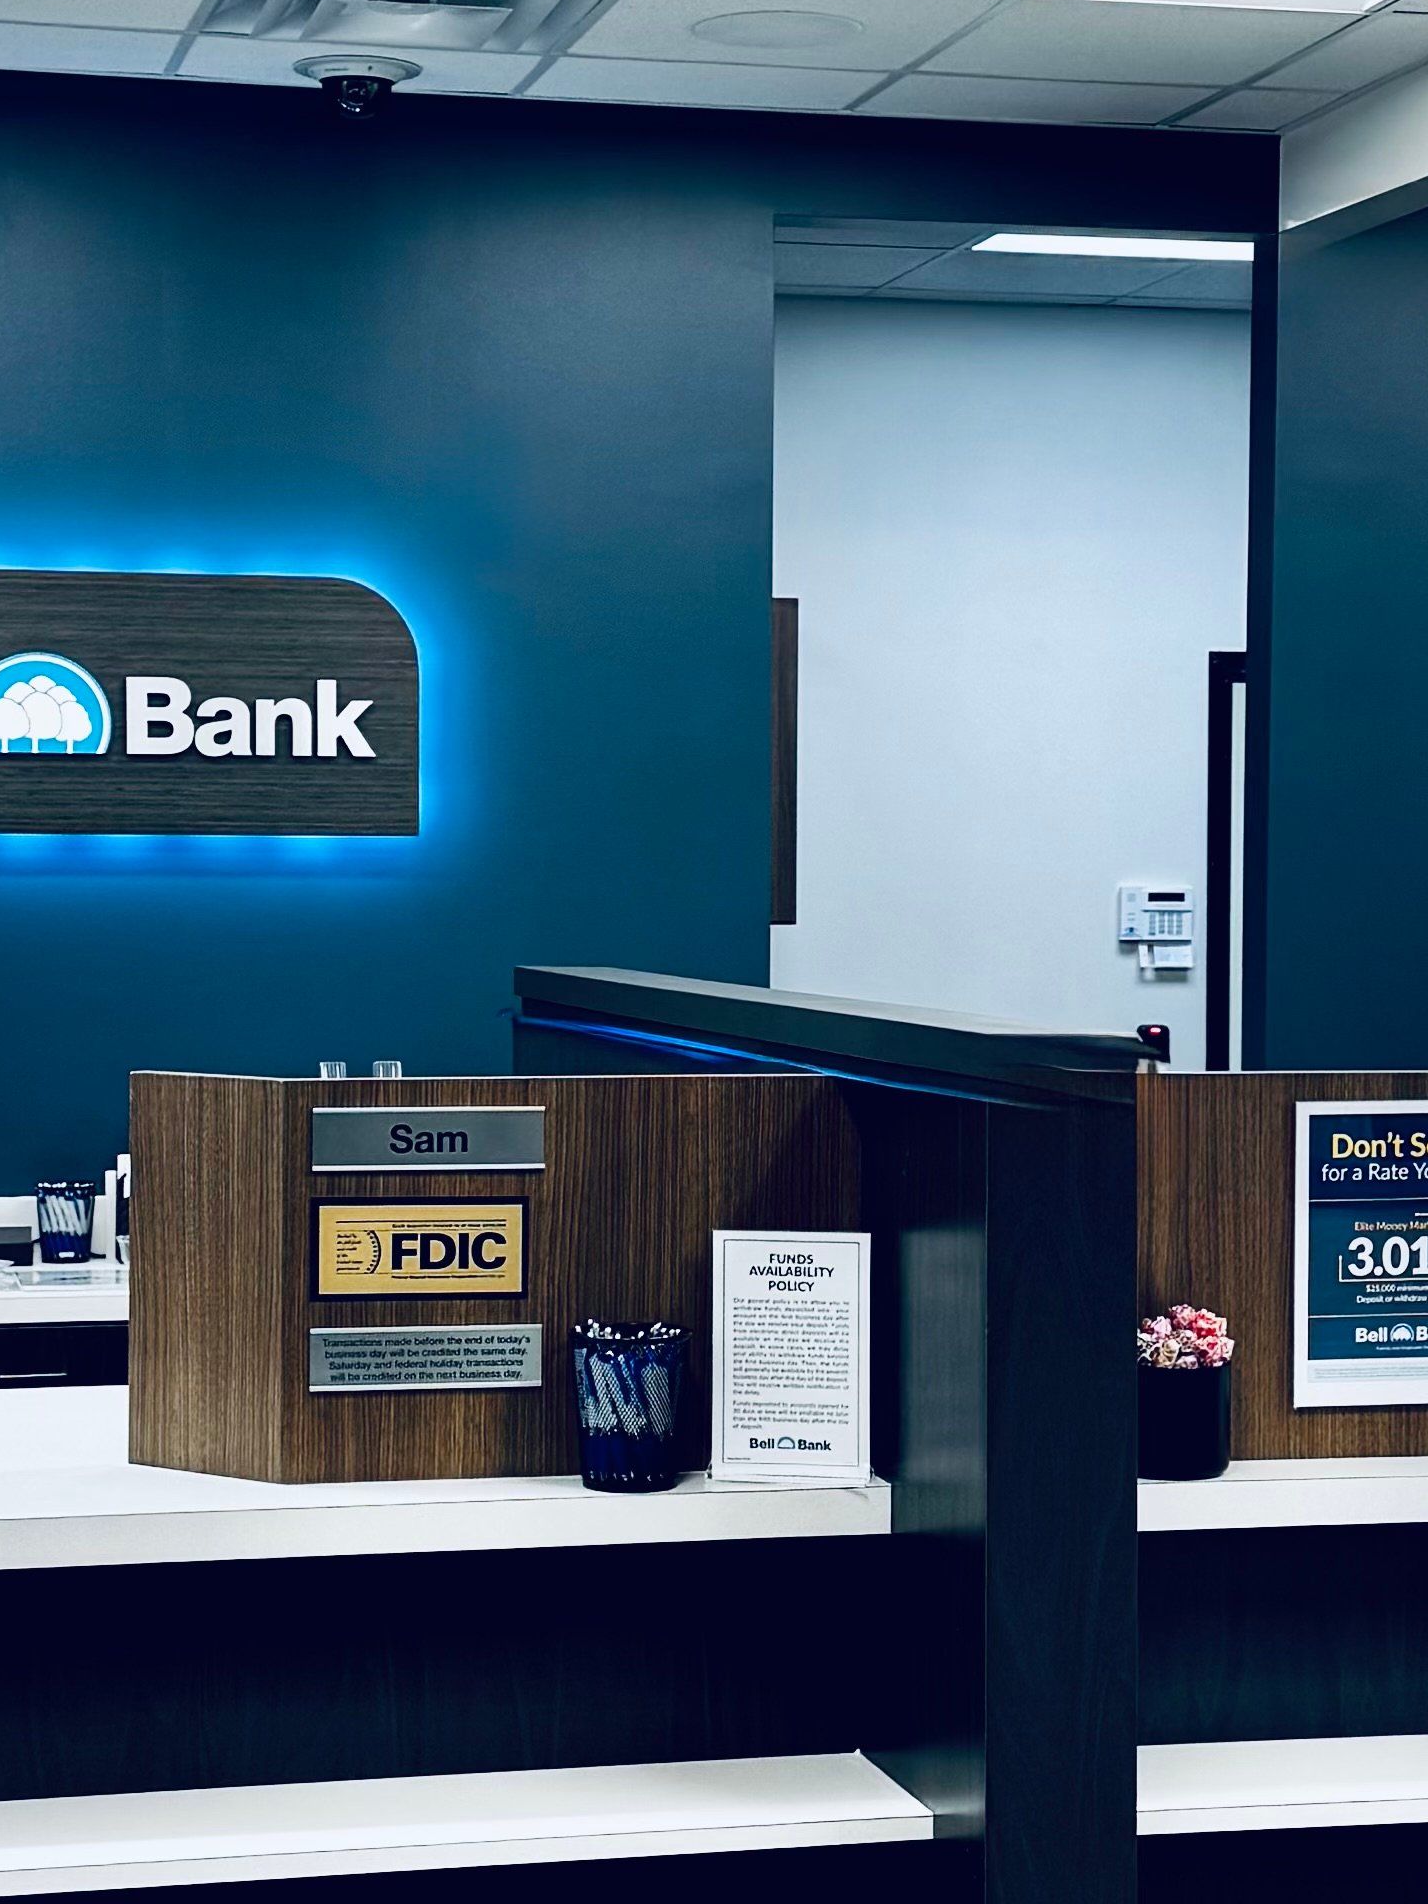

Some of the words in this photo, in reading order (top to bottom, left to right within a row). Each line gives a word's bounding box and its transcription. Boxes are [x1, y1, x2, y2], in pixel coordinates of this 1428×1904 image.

[126, 676, 376, 758] Bank
[389, 1124, 469, 1154] Sam
[1332, 1132, 1404, 1159] Don't
[1322, 1163, 1348, 1182] for
[1352, 1167, 1362, 1181] a
[1369, 1163, 1409, 1180] Rate
[1354, 1221, 1374, 1231] Elite
[1376, 1221, 1408, 1232] Money
[391, 1232, 507, 1270] FDIC
[769, 1253, 814, 1264] FUNDS
[749, 1265, 834, 1277] AVAILABILITY
[768, 1280, 815, 1292] POLICY
[322, 1338, 383, 1348] Transactions
[385, 1337, 411, 1347] made
[414, 1336, 444, 1346] before
[447, 1335, 462, 1345] the
[464, 1335, 482, 1345] end
[484, 1334, 495, 1344] of
[1355, 1327, 1388, 1343] Bell
[324, 1349, 367, 1359] business
[369, 1349, 387, 1360] day
[389, 1348, 405, 1358] will
[407, 1348, 419, 1357] be
[421, 1347, 461, 1357] credited
[463, 1347, 478, 1356] the
[480, 1347, 506, 1356] same
[329, 1360, 371, 1371] Saturday
[374, 1360, 391, 1369] and
[394, 1359, 427, 1369] federal
[429, 1358, 463, 1370] holiday
[465, 1357, 523, 1367] transactions
[347, 1371, 360, 1381] be
[362, 1371, 402, 1381] credited
[404, 1372, 416, 1380] on
[418, 1370, 434, 1380] the
[436, 1371, 457, 1380] next
[459, 1369, 501, 1379] business
[749, 1438, 775, 1449] Bell
[798, 1439, 832, 1451] Bank
